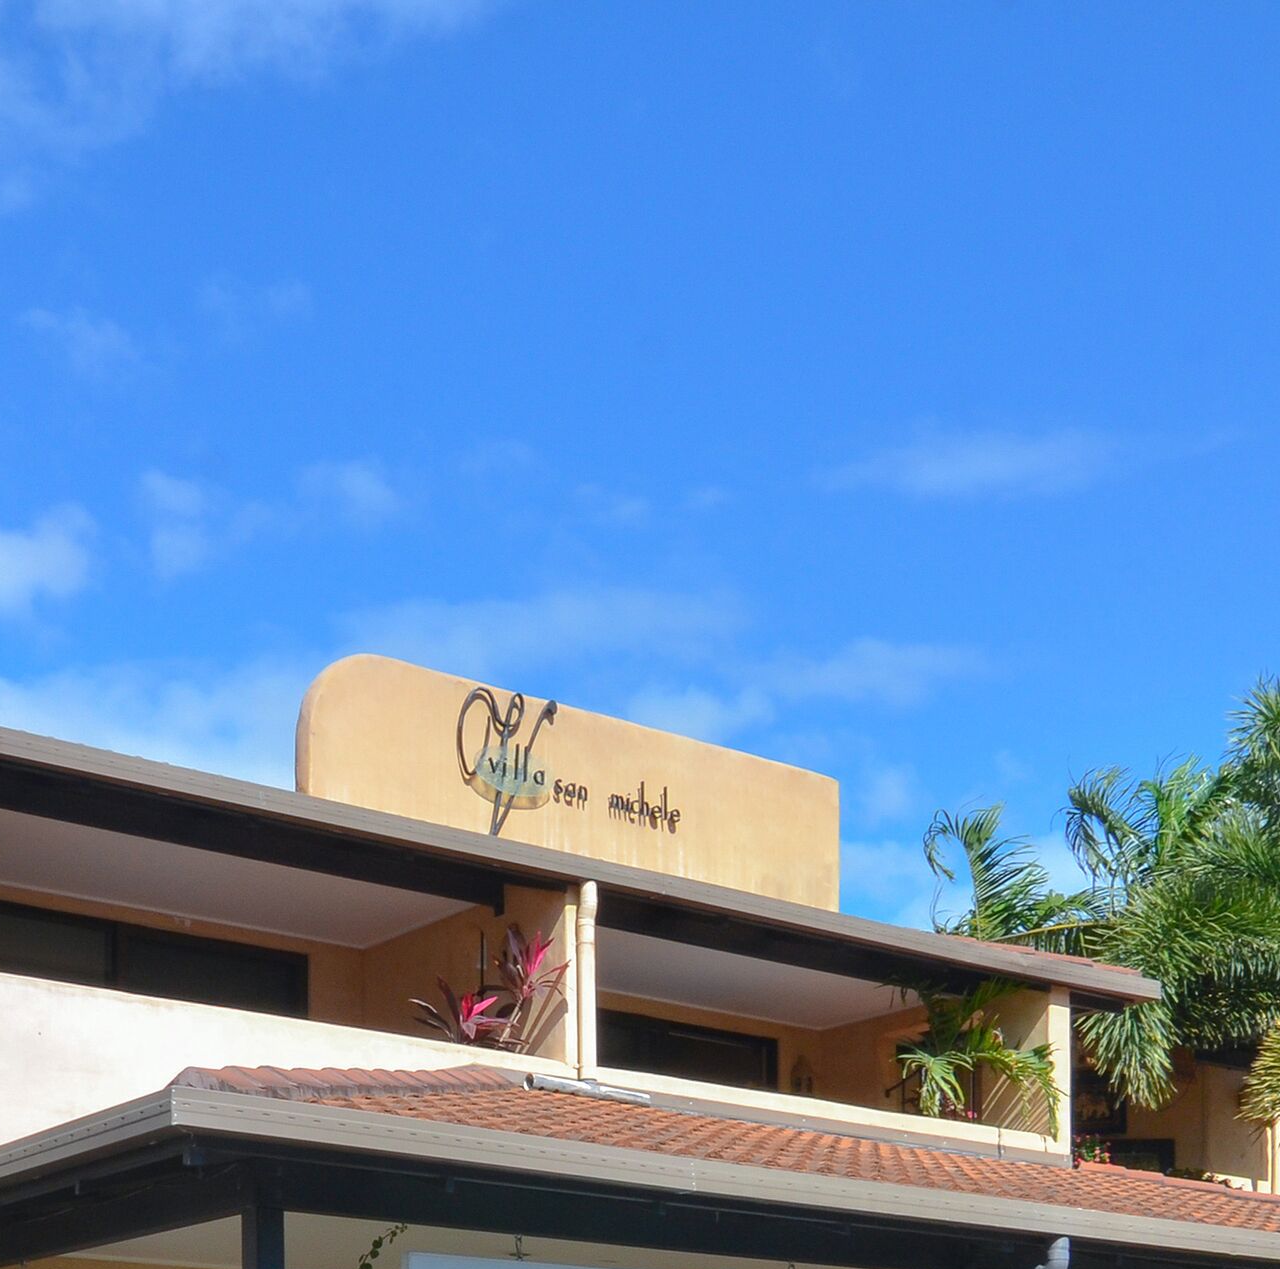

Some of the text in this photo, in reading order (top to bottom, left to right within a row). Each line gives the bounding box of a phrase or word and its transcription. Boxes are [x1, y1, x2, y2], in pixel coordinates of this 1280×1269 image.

[487, 742, 681, 825] villa san michele
